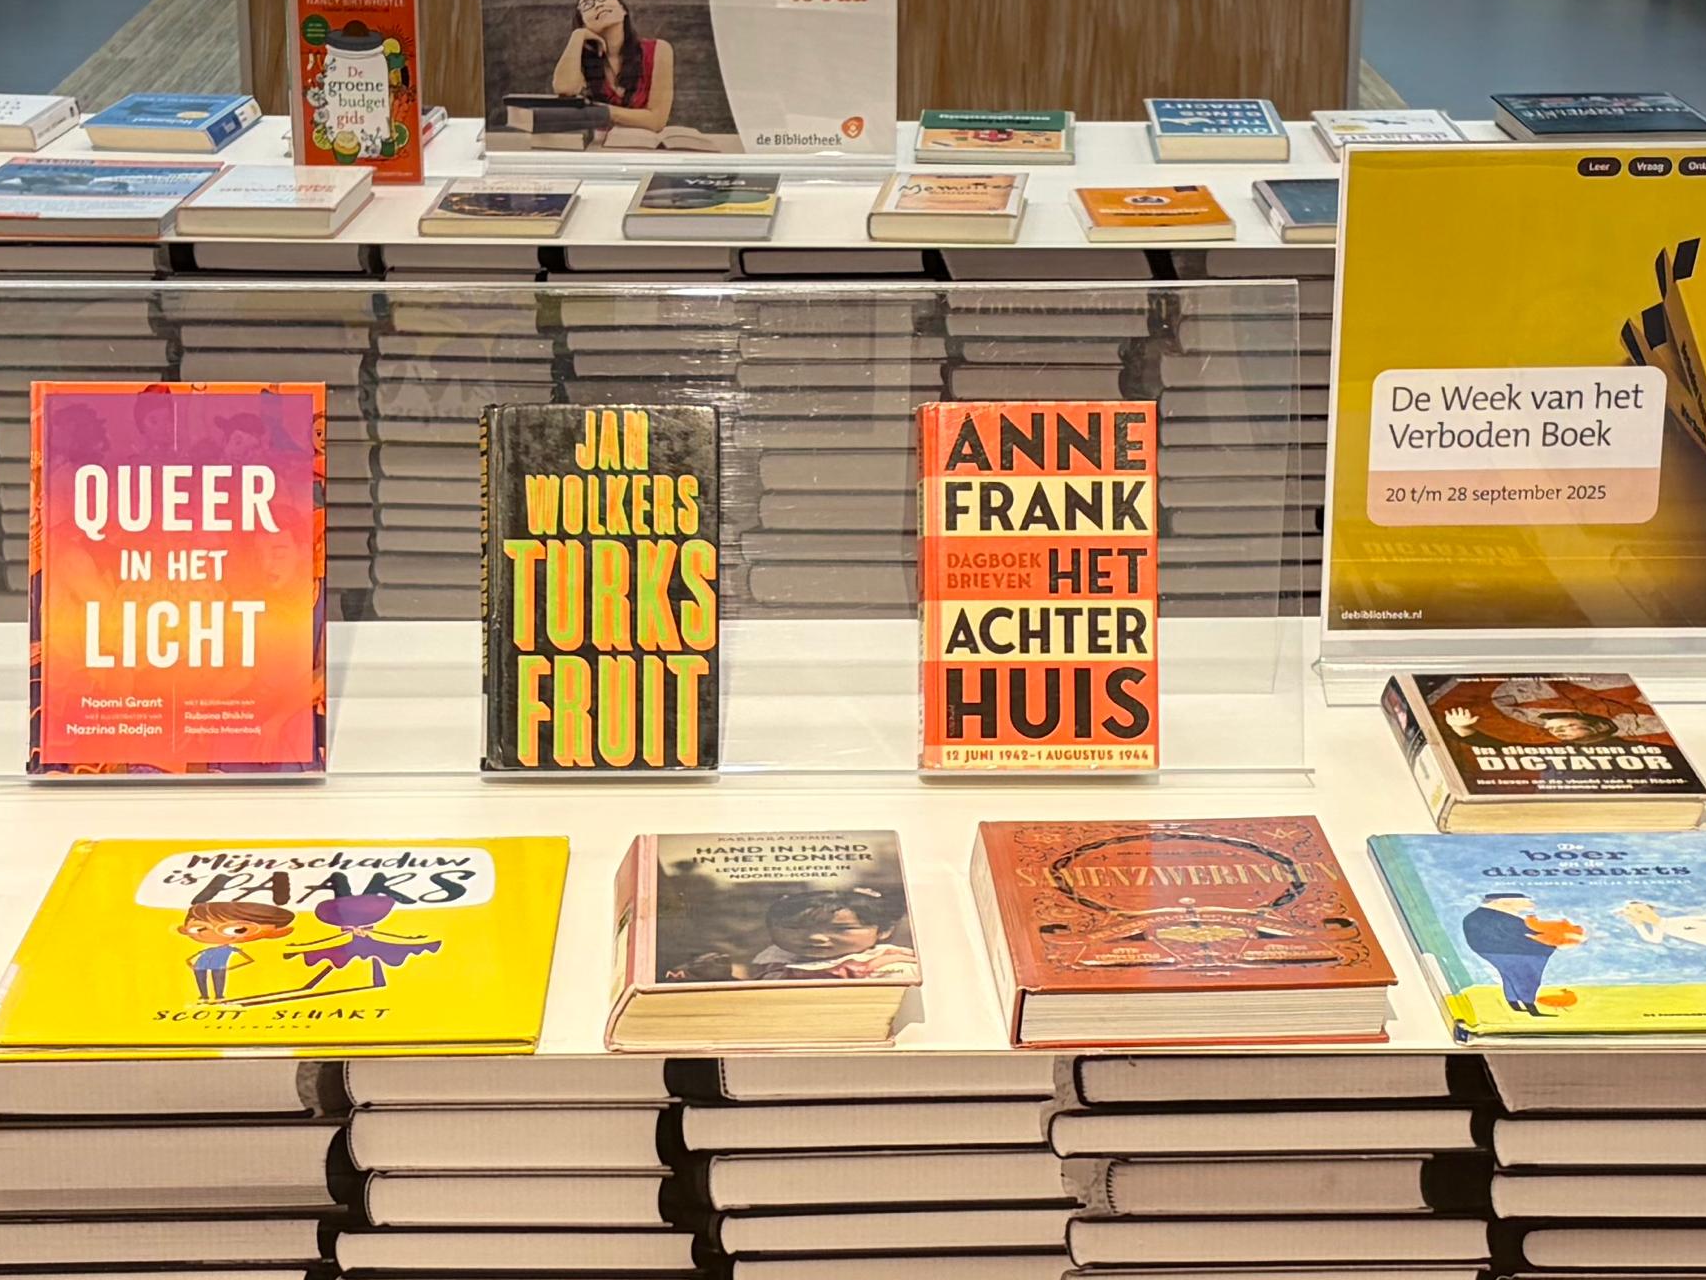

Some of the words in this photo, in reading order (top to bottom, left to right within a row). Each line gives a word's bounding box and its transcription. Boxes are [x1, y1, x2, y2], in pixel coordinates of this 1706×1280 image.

[347, 66, 364, 78] De
[327, 78, 384, 97] groene
[338, 94, 387, 114] budget
[336, 110, 366, 129] gids
[756, 133, 772, 146] de
[774, 133, 843, 147] Bibliotheek
[1637, 162, 1664, 174] Vraag
[1392, 386, 1431, 412] De
[1441, 383, 1522, 411] Week
[1530, 390, 1584, 410] van
[1594, 381, 1644, 410] het
[575, 410, 648, 470] JAN
[945, 411, 1147, 472] ANNE
[1388, 420, 1530, 449] Verboden
[1541, 419, 1612, 448] Boek
[74, 464, 280, 541] QUEER
[1385, 487, 1406, 503] 20
[1410, 485, 1442, 504] t/m
[1447, 486, 1468, 502] 28
[1472, 484, 1563, 505] september
[1566, 484, 1607, 500] 2025
[525, 475, 698, 535] WOLKERS
[945, 480, 1148, 531] FRANK
[120, 549, 152, 582] IN
[167, 549, 228, 582] HET
[947, 552, 1042, 569] DAGBOEK
[1048, 547, 1144, 594] HET
[947, 572, 1032, 589] BRIEVEN
[504, 539, 716, 651] TURKS
[1340, 609, 1423, 620] debibliotheek.nl
[85, 600, 266, 668] LICHT
[945, 606, 1148, 655] ACHTER
[124, 696, 163, 708] Grant
[945, 666, 1150, 739] HUIS
[517, 655, 709, 770] FRUIT
[118, 723, 163, 737] Rodjan
[946, 750, 959, 761] 12
[964, 749, 994, 762] JUNI
[999, 749, 1042, 761] 1942-1
[1045, 749, 1114, 761] AUGUSTUS
[1119, 749, 1149, 761] 1944
[1472, 746, 1496, 755] In
[1501, 745, 1576, 755] dienst
[1581, 746, 1624, 755] van
[1630, 745, 1662, 755] de
[1476, 755, 1673, 770] DICTATOR
[693, 856, 715, 864] IN
[724, 854, 768, 863] HET
[775, 853, 874, 862] DONKER
[696, 846, 763, 854] HAND
[770, 845, 794, 853] IN
[802, 844, 869, 853] HAND
[1519, 849, 1629, 861] boer
[187, 853, 290, 872] Mijn
[291, 852, 471, 870] schaduw
[1482, 866, 1691, 877] dierenarts
[1015, 862, 1344, 888] SAMENZWERINGEN
[191, 870, 476, 906] PAARS
[153, 1010, 248, 1021] SCOTT
